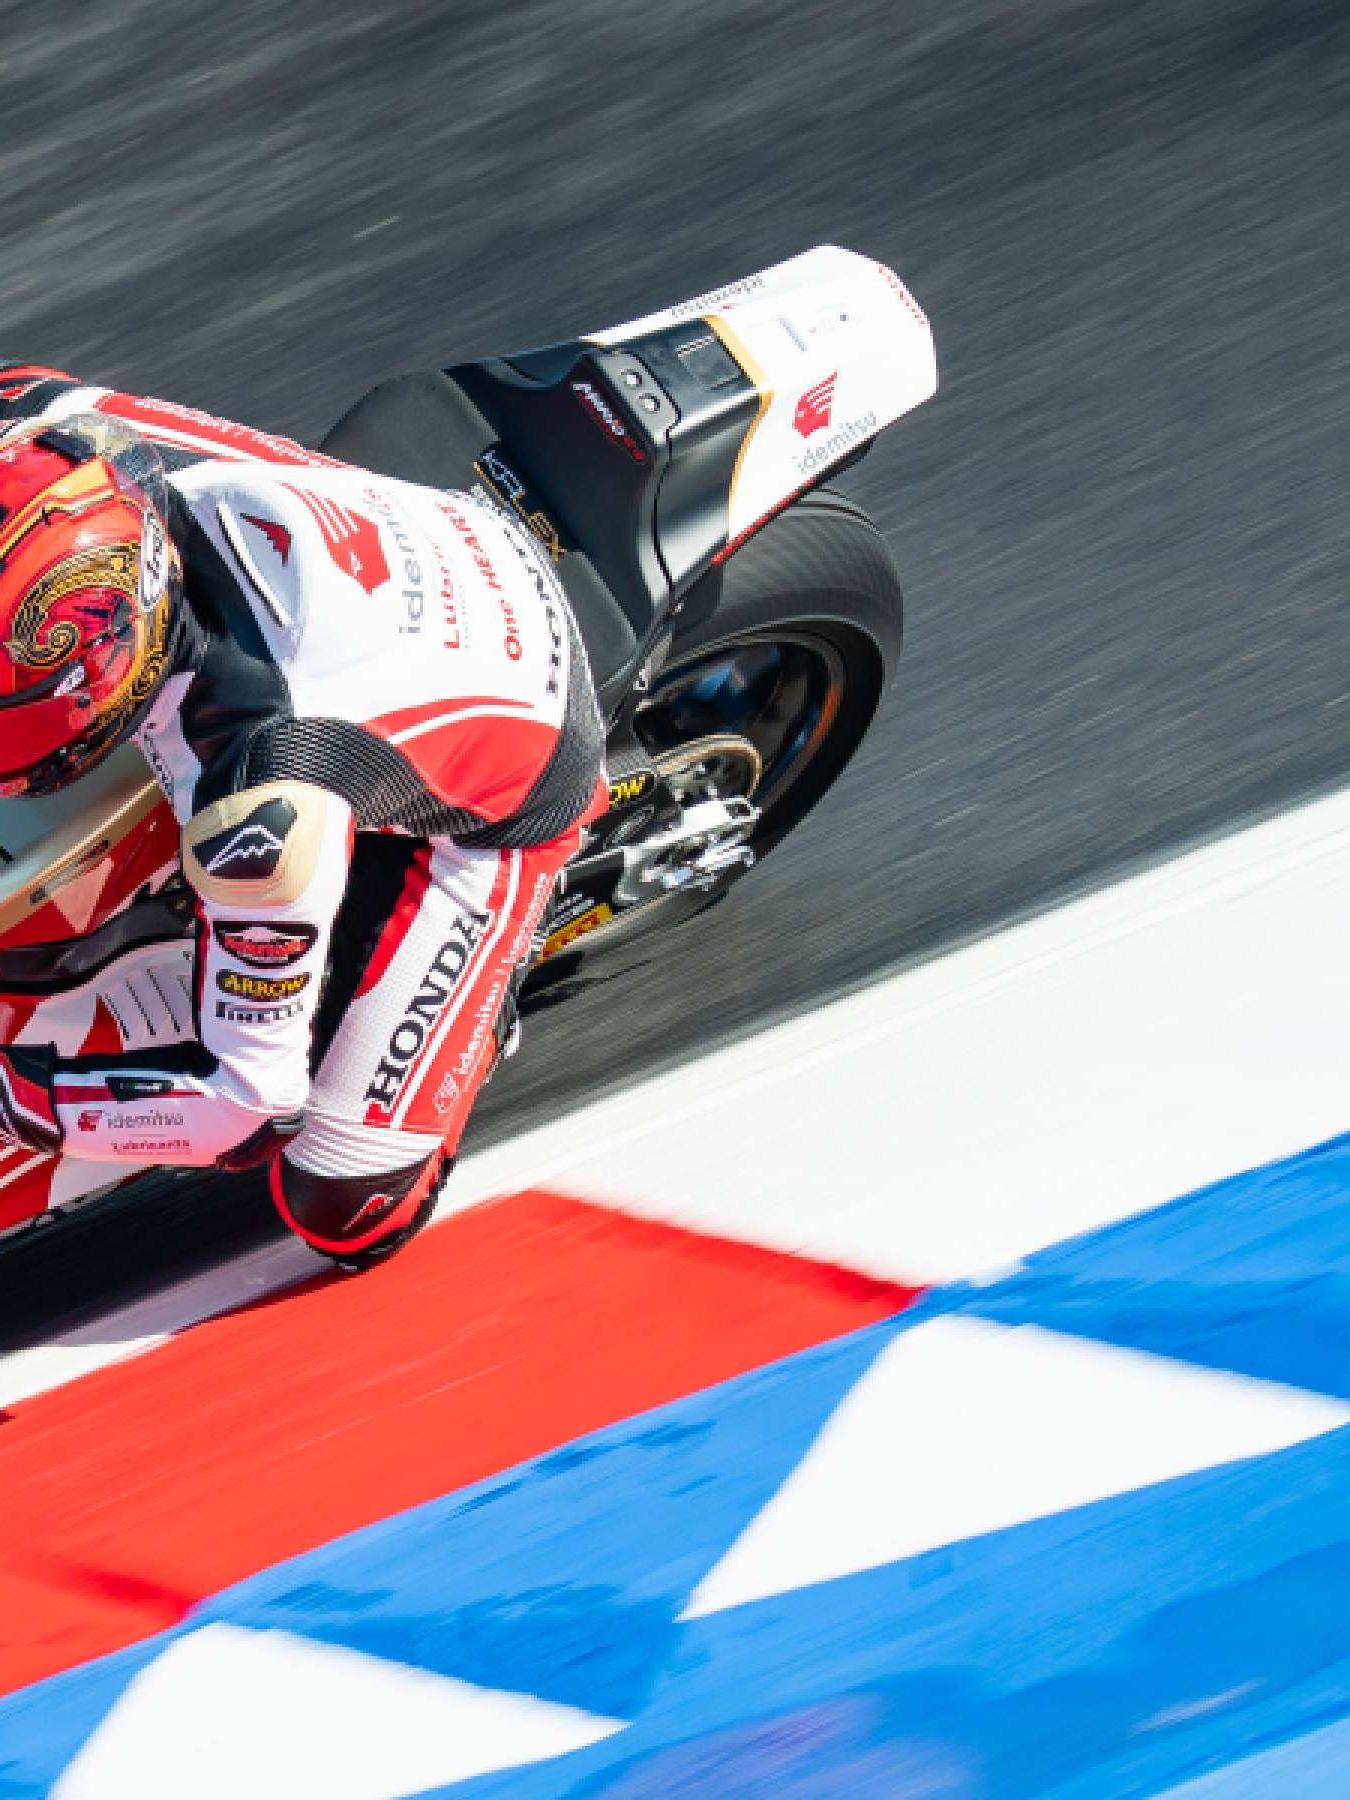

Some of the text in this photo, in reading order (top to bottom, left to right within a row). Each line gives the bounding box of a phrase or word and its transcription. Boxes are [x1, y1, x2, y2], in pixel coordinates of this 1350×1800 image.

[792, 411, 878, 475] idemitsu
[223, 974, 307, 998] ARROW
[215, 1000, 304, 1024] PIRELLI
[363, 914, 490, 1108] HONDA
[107, 1108, 184, 1129] idemitsu
